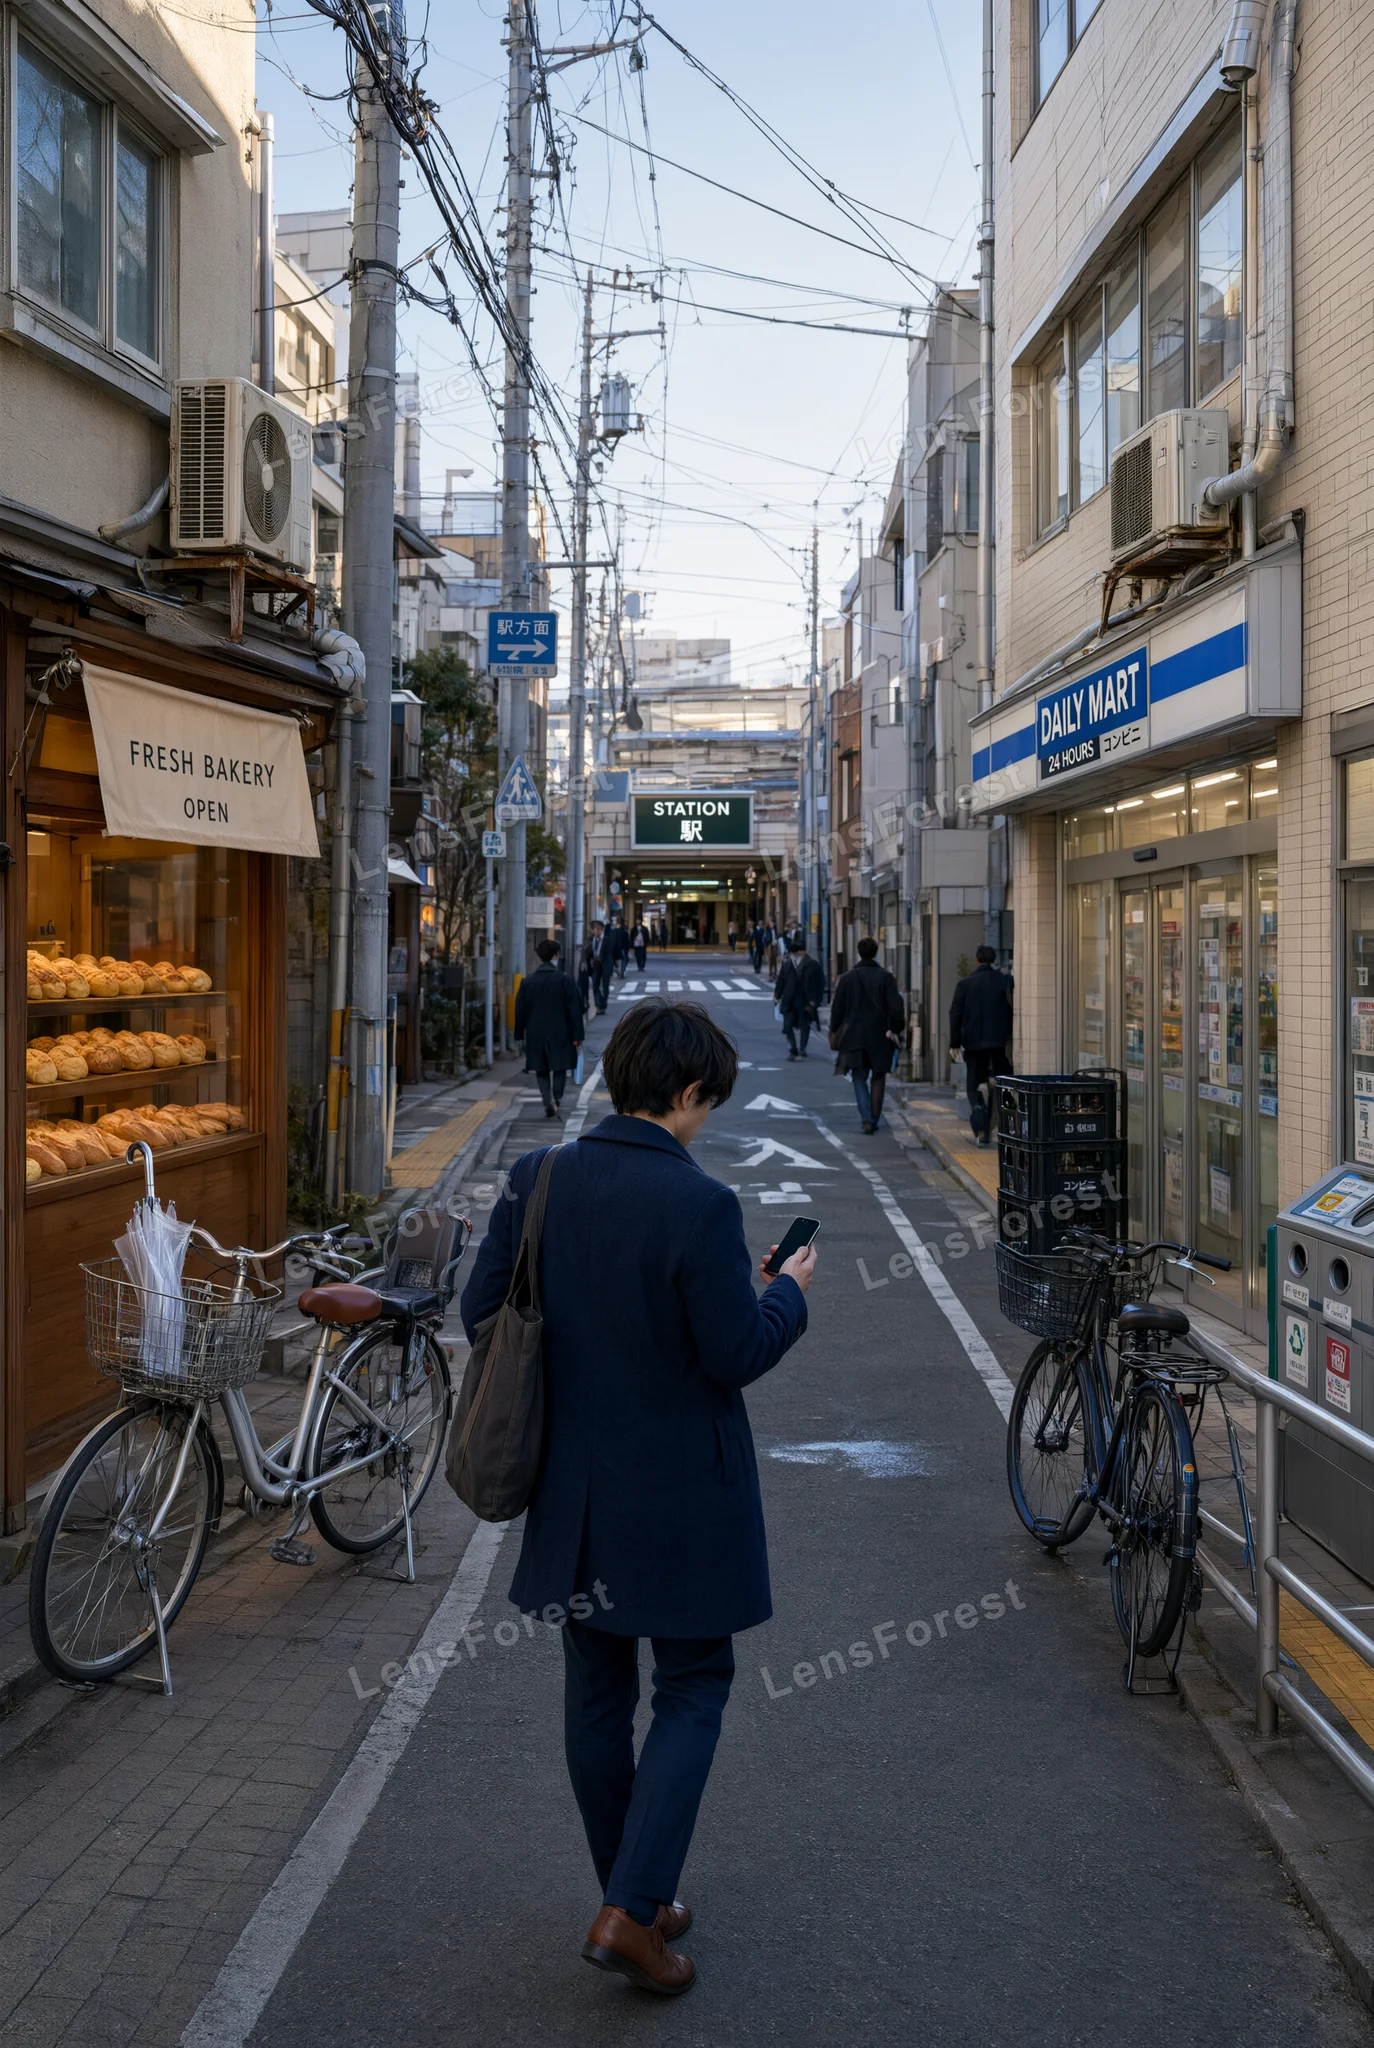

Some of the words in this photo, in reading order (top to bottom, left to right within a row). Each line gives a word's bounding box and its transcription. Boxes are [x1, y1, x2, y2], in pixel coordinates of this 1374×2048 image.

[497, 619, 550, 636] 駅方面
[1041, 689, 1085, 746] DAILY
[1088, 661, 1140, 725] MART
[1103, 726, 1142, 753] コンビニ
[129, 740, 194, 775] FRESH
[204, 754, 275, 788] BAKERY
[1048, 754, 1061, 773] 24
[1062, 739, 1095, 768] HOURS
[183, 797, 229, 823] OPEN
[653, 801, 730, 816] STATION
[680, 820, 703, 842] 駅
